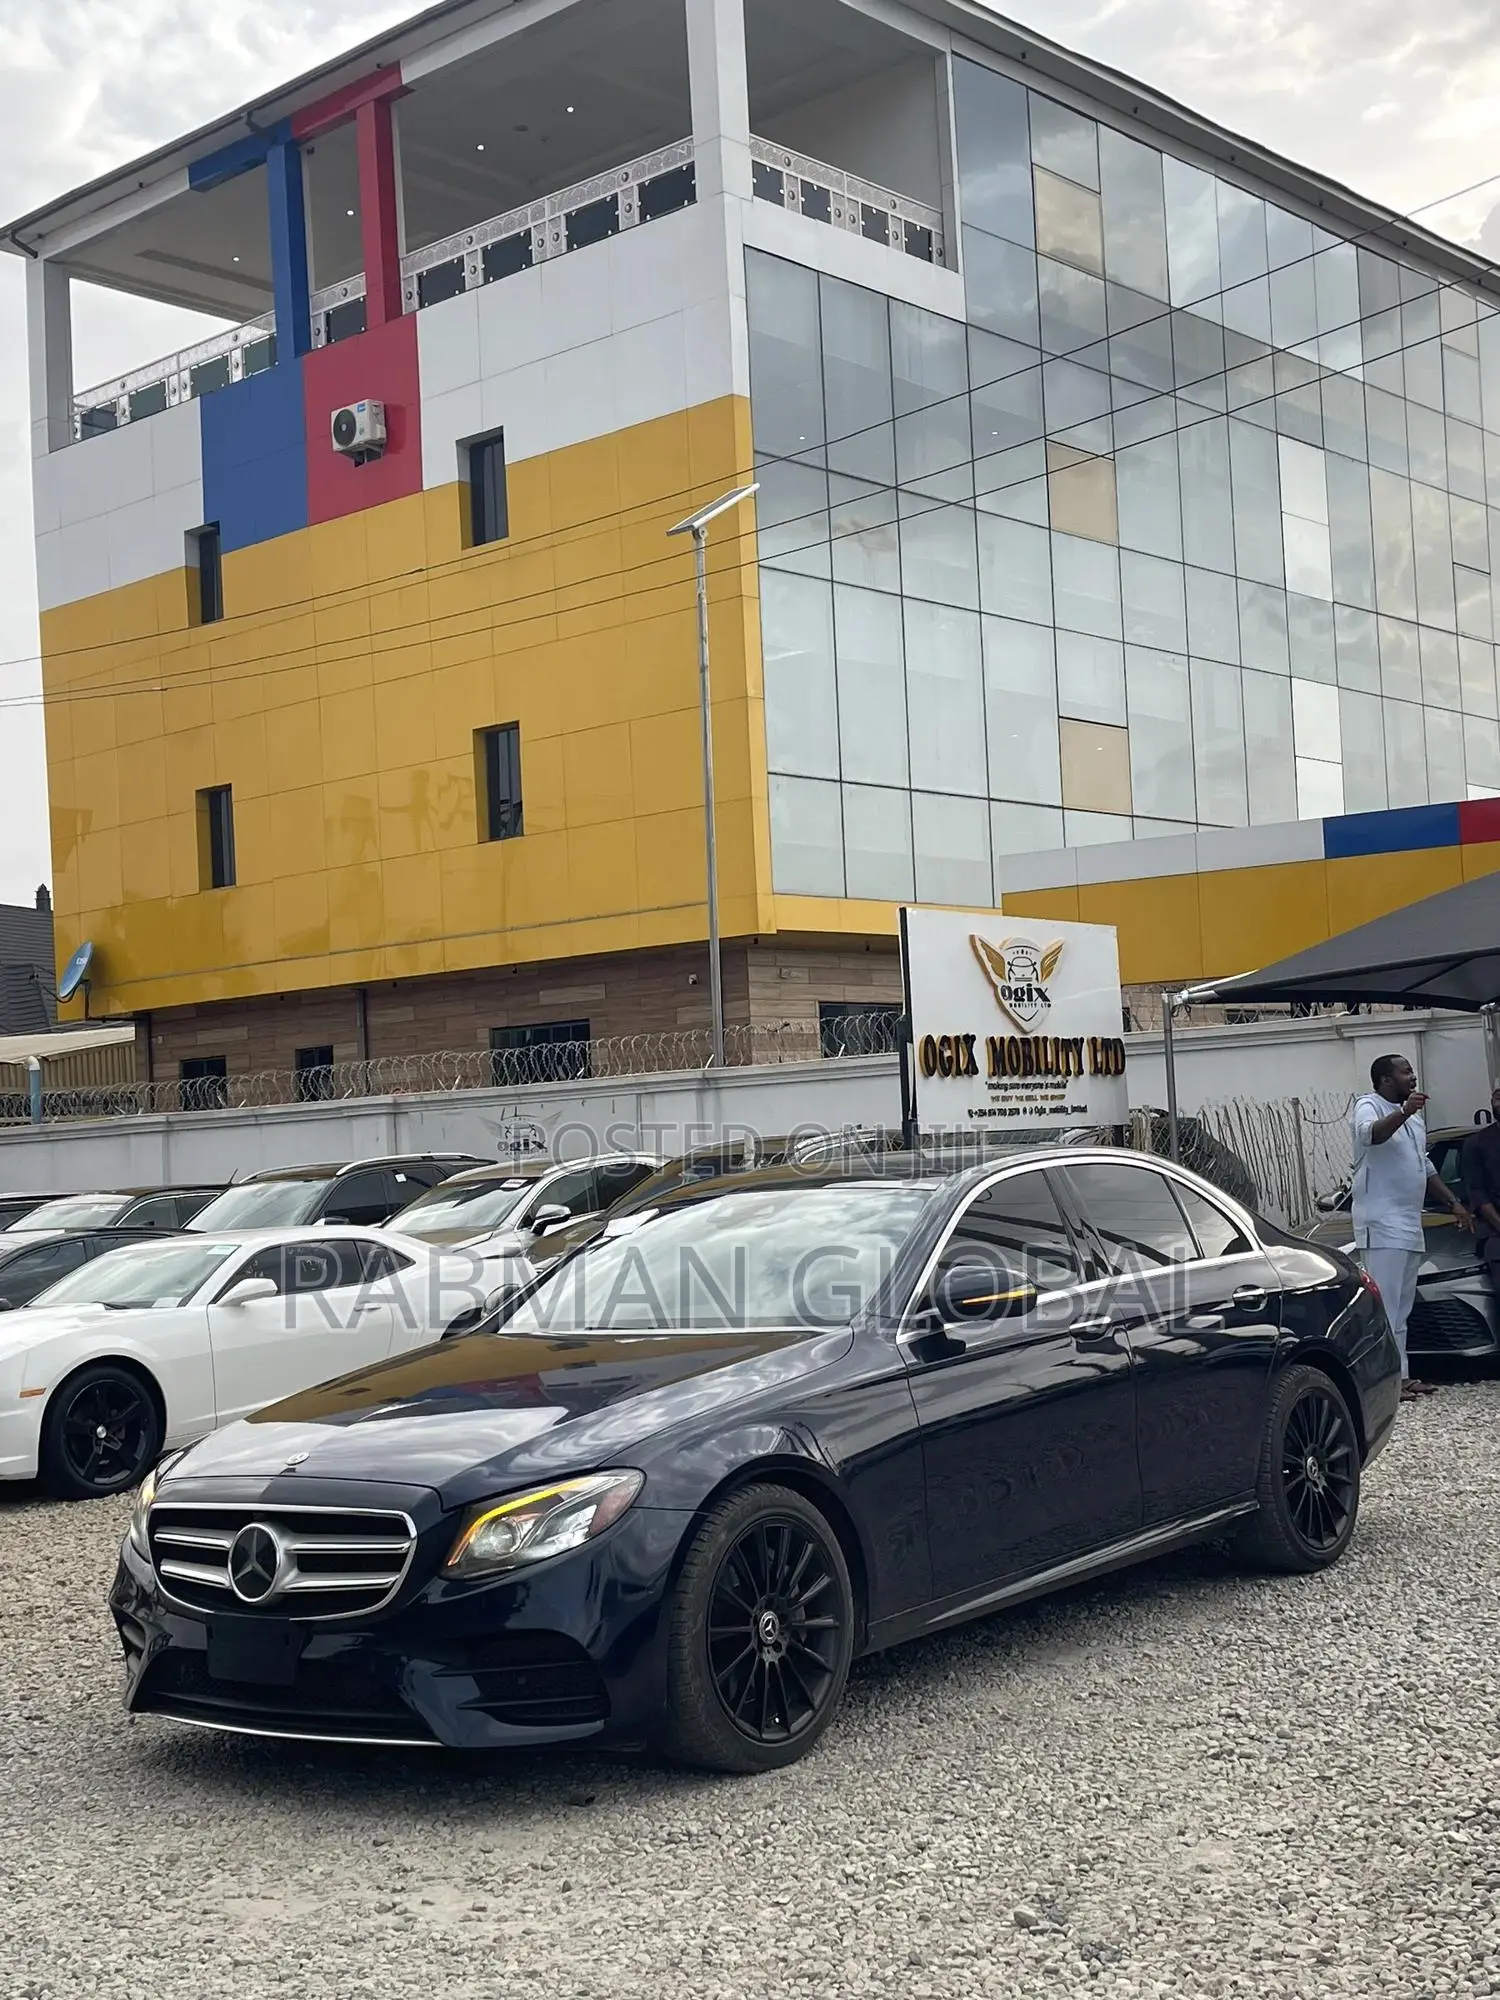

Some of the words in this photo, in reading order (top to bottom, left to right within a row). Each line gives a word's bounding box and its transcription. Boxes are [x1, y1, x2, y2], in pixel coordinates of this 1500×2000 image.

[1000, 983, 1051, 1003] Ogix
[919, 1033, 979, 1077] OGIX
[985, 1034, 1084, 1077] MOBILITY
[1086, 1036, 1127, 1077] LTD
